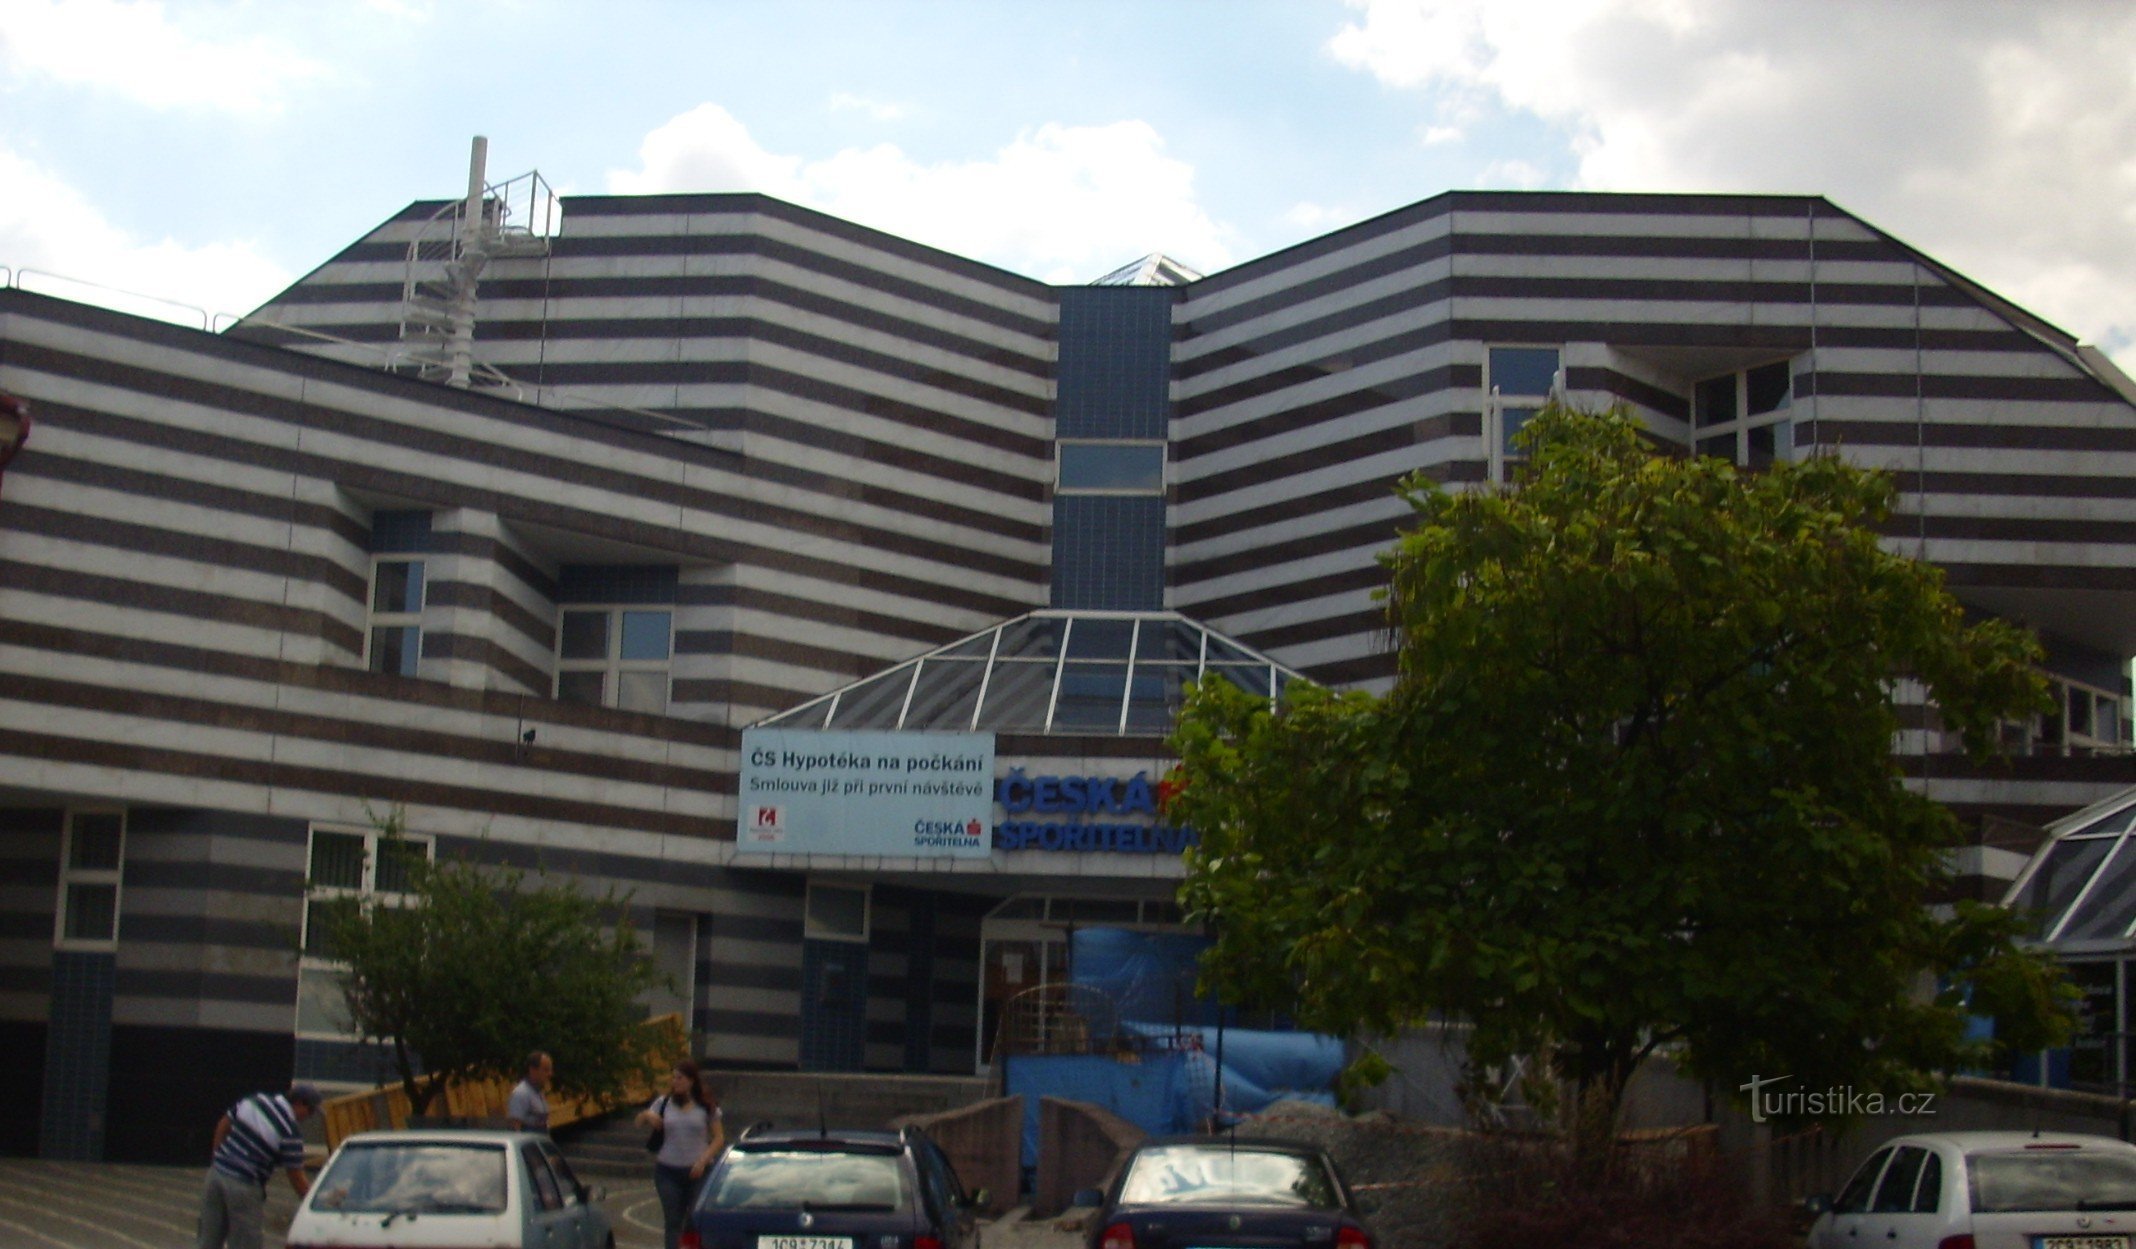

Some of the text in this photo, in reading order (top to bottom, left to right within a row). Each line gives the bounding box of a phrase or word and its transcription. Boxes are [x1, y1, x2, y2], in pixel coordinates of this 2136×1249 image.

[751, 747, 984, 773] ČS Hypotéka na počkání
[750, 777, 817, 792] Smlouva
[844, 778, 863, 796] při
[869, 780, 908, 796] první
[1000, 766, 1153, 814] ČESKÁ
[914, 817, 965, 835] ČESKÁ
[1000, 813, 1200, 854] SPOŘITELNA
[914, 834, 980, 847] SPOŘITELNA
